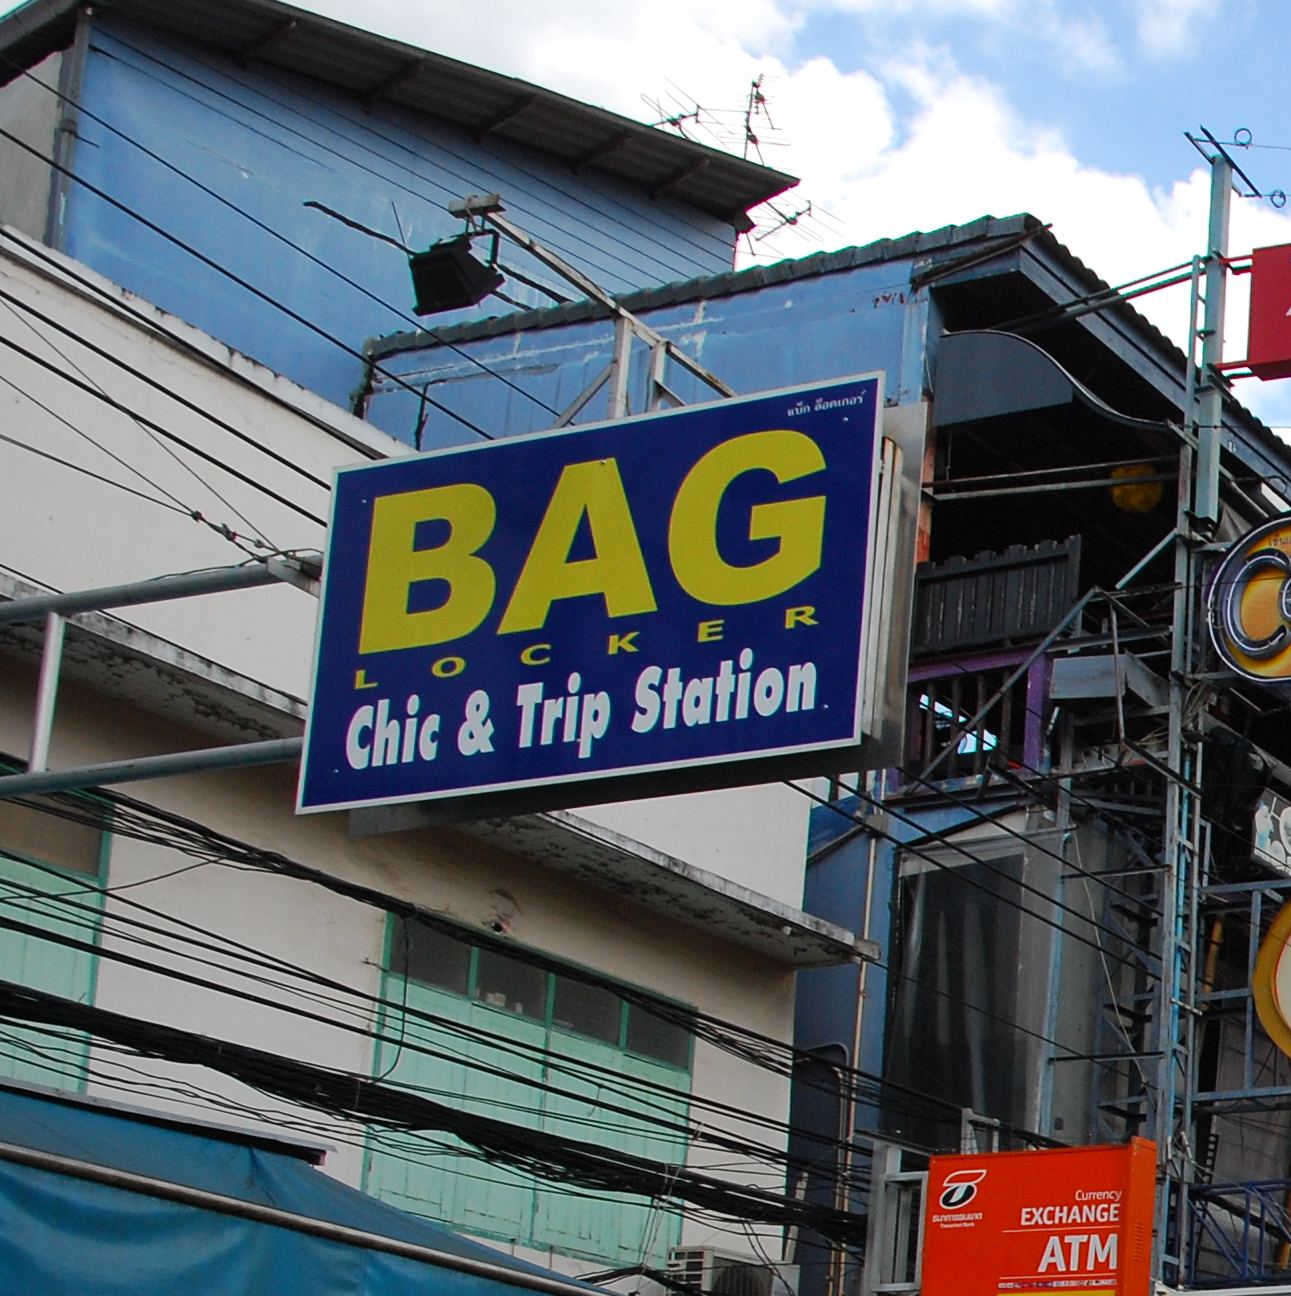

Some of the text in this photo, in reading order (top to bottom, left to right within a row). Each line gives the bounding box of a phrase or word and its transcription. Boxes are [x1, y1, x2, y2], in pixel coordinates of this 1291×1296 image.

[358, 429, 828, 655] BAG
[354, 605, 819, 690] LOCKER
[345, 648, 817, 771] Chic & Trip Station
[1020, 1203, 1121, 1226] EXCHANGE
[1075, 1189, 1122, 1202] Currency
[1037, 1233, 1118, 1273] ATM
